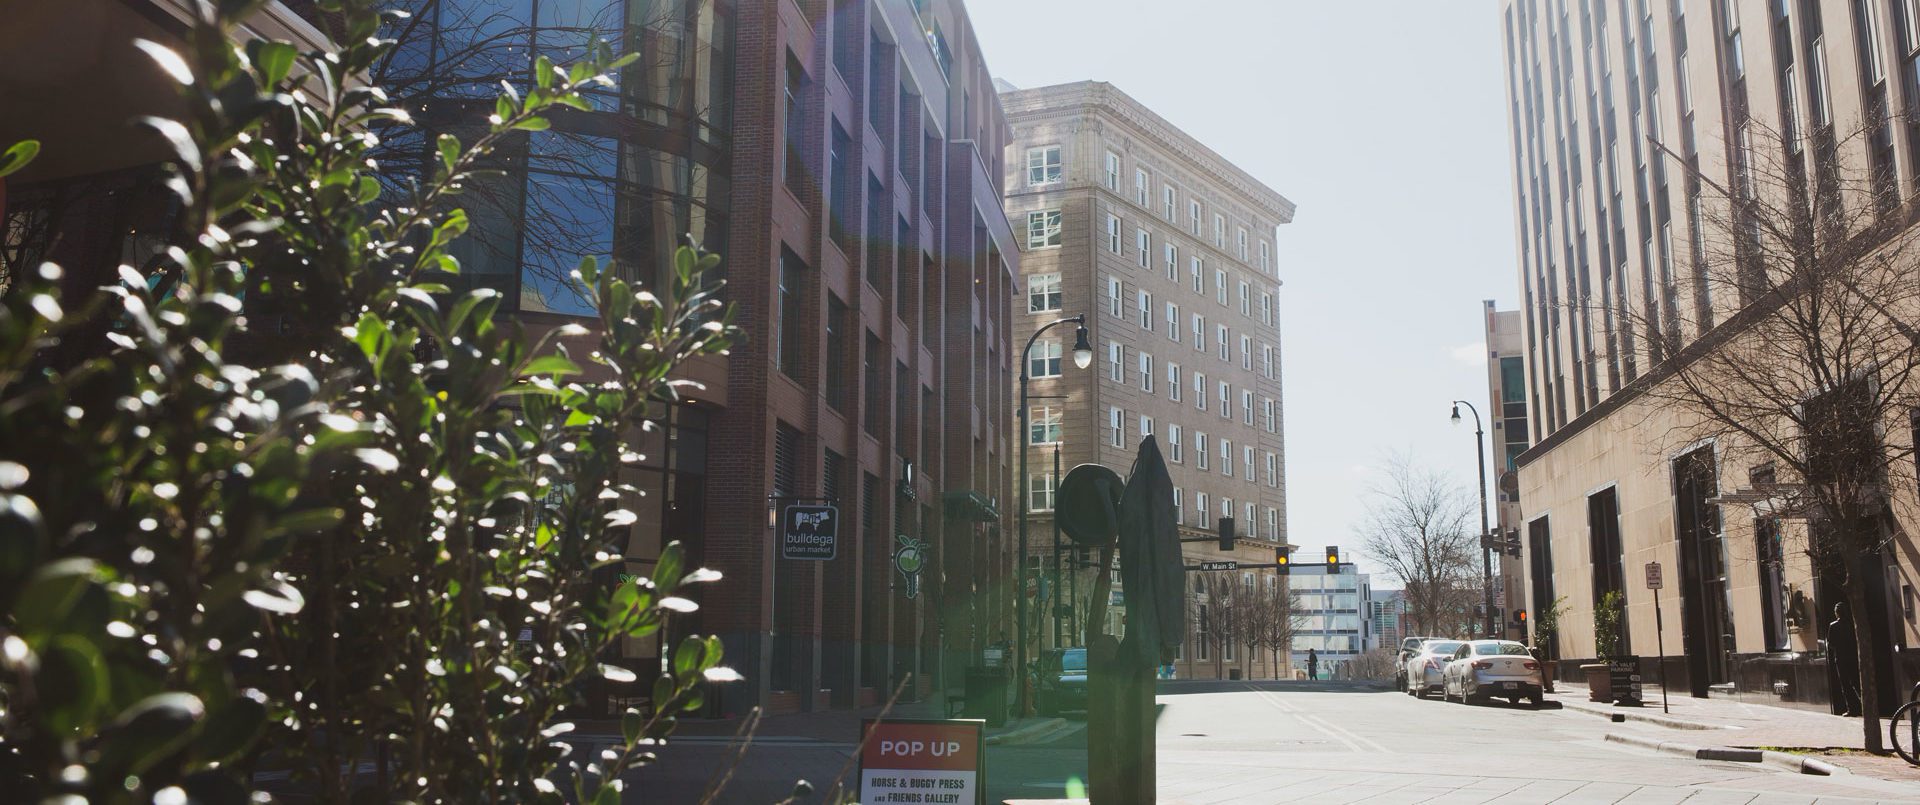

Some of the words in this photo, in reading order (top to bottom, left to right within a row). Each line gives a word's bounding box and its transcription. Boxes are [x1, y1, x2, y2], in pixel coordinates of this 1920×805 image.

[787, 533, 833, 546] bulldega
[881, 741, 924, 756] POP
[931, 742, 960, 757] UP
[871, 777, 897, 788] HORSE
[899, 778, 907, 788] &
[910, 778, 937, 789] BUGGY
[939, 779, 965, 789] PRESS
[887, 792, 922, 803] FRIENDS
[924, 793, 960, 804] GALLERY
